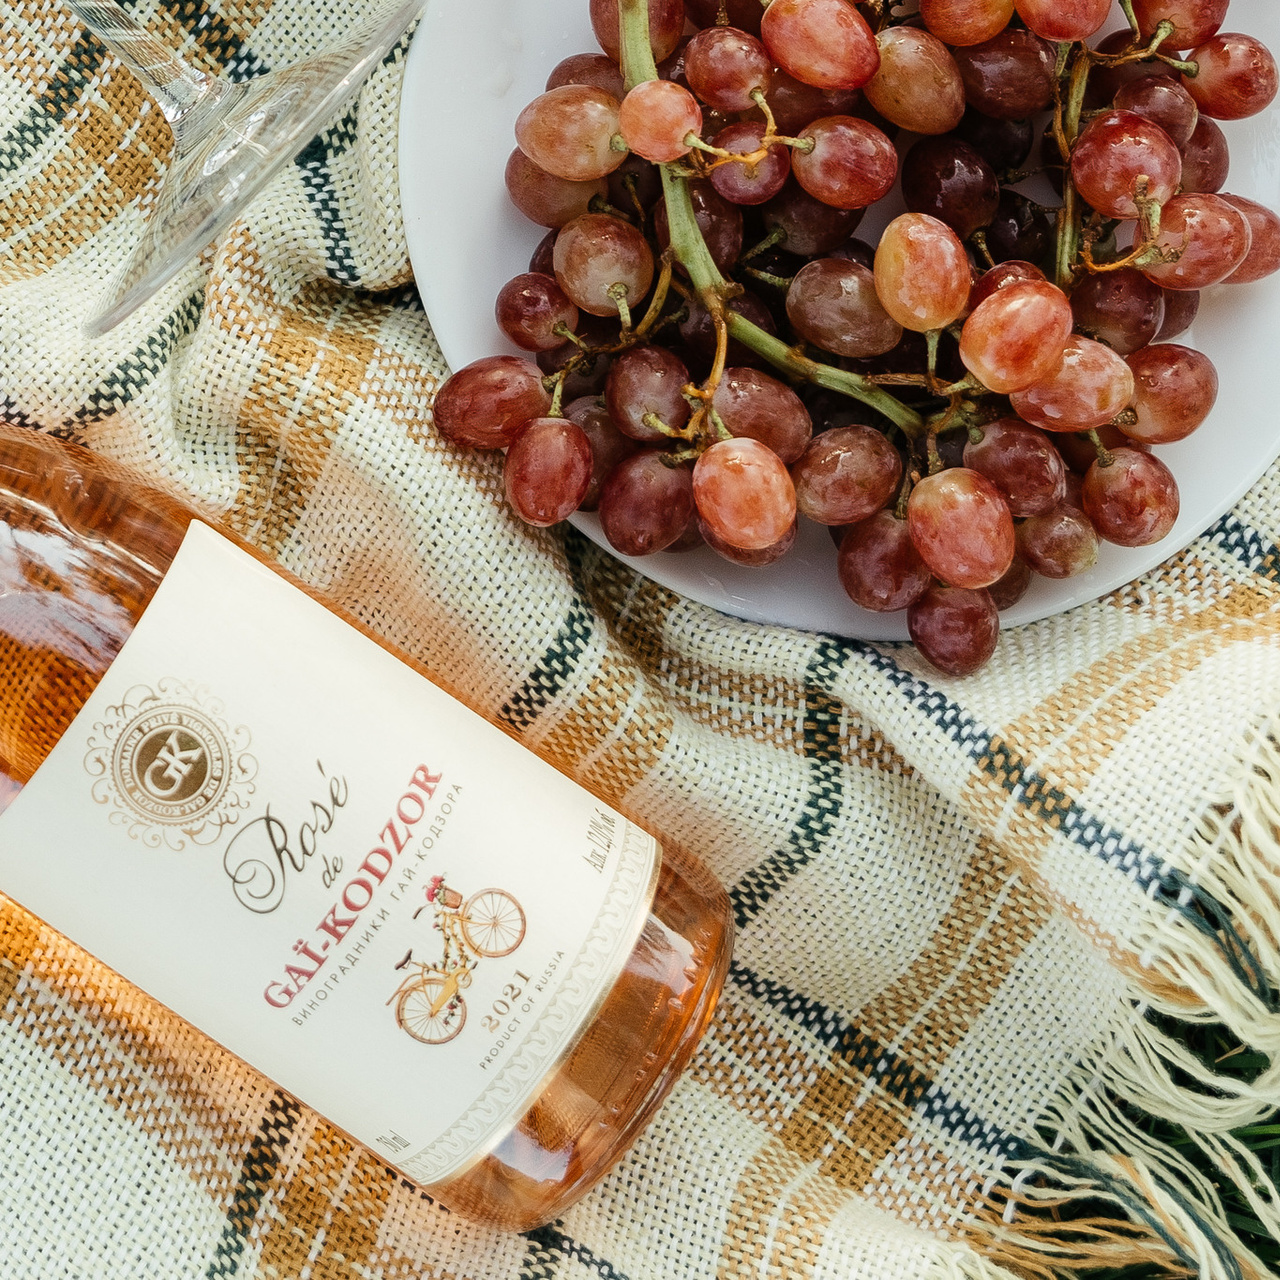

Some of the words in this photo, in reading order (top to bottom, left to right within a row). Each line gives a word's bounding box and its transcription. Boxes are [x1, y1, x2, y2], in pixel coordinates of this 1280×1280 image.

[120, 726, 143, 788] DOMAINE
[181, 714, 223, 778] VIGNOBLES
[203, 779, 220, 798] DE
[223, 758, 348, 914] Rosé
[263, 763, 443, 1009] GAÏ-KODZOR
[321, 853, 343, 889] de
[291, 907, 391, 1026] ВИНОГРАДНИКИ
[390, 783, 463, 901] ГАЙ-КОДЗОРА
[479, 1017, 521, 1070] PRODUCT
[521, 996, 535, 1013] OF
[535, 950, 565, 992] RUSSIA
[480, 969, 533, 1034] 2021
